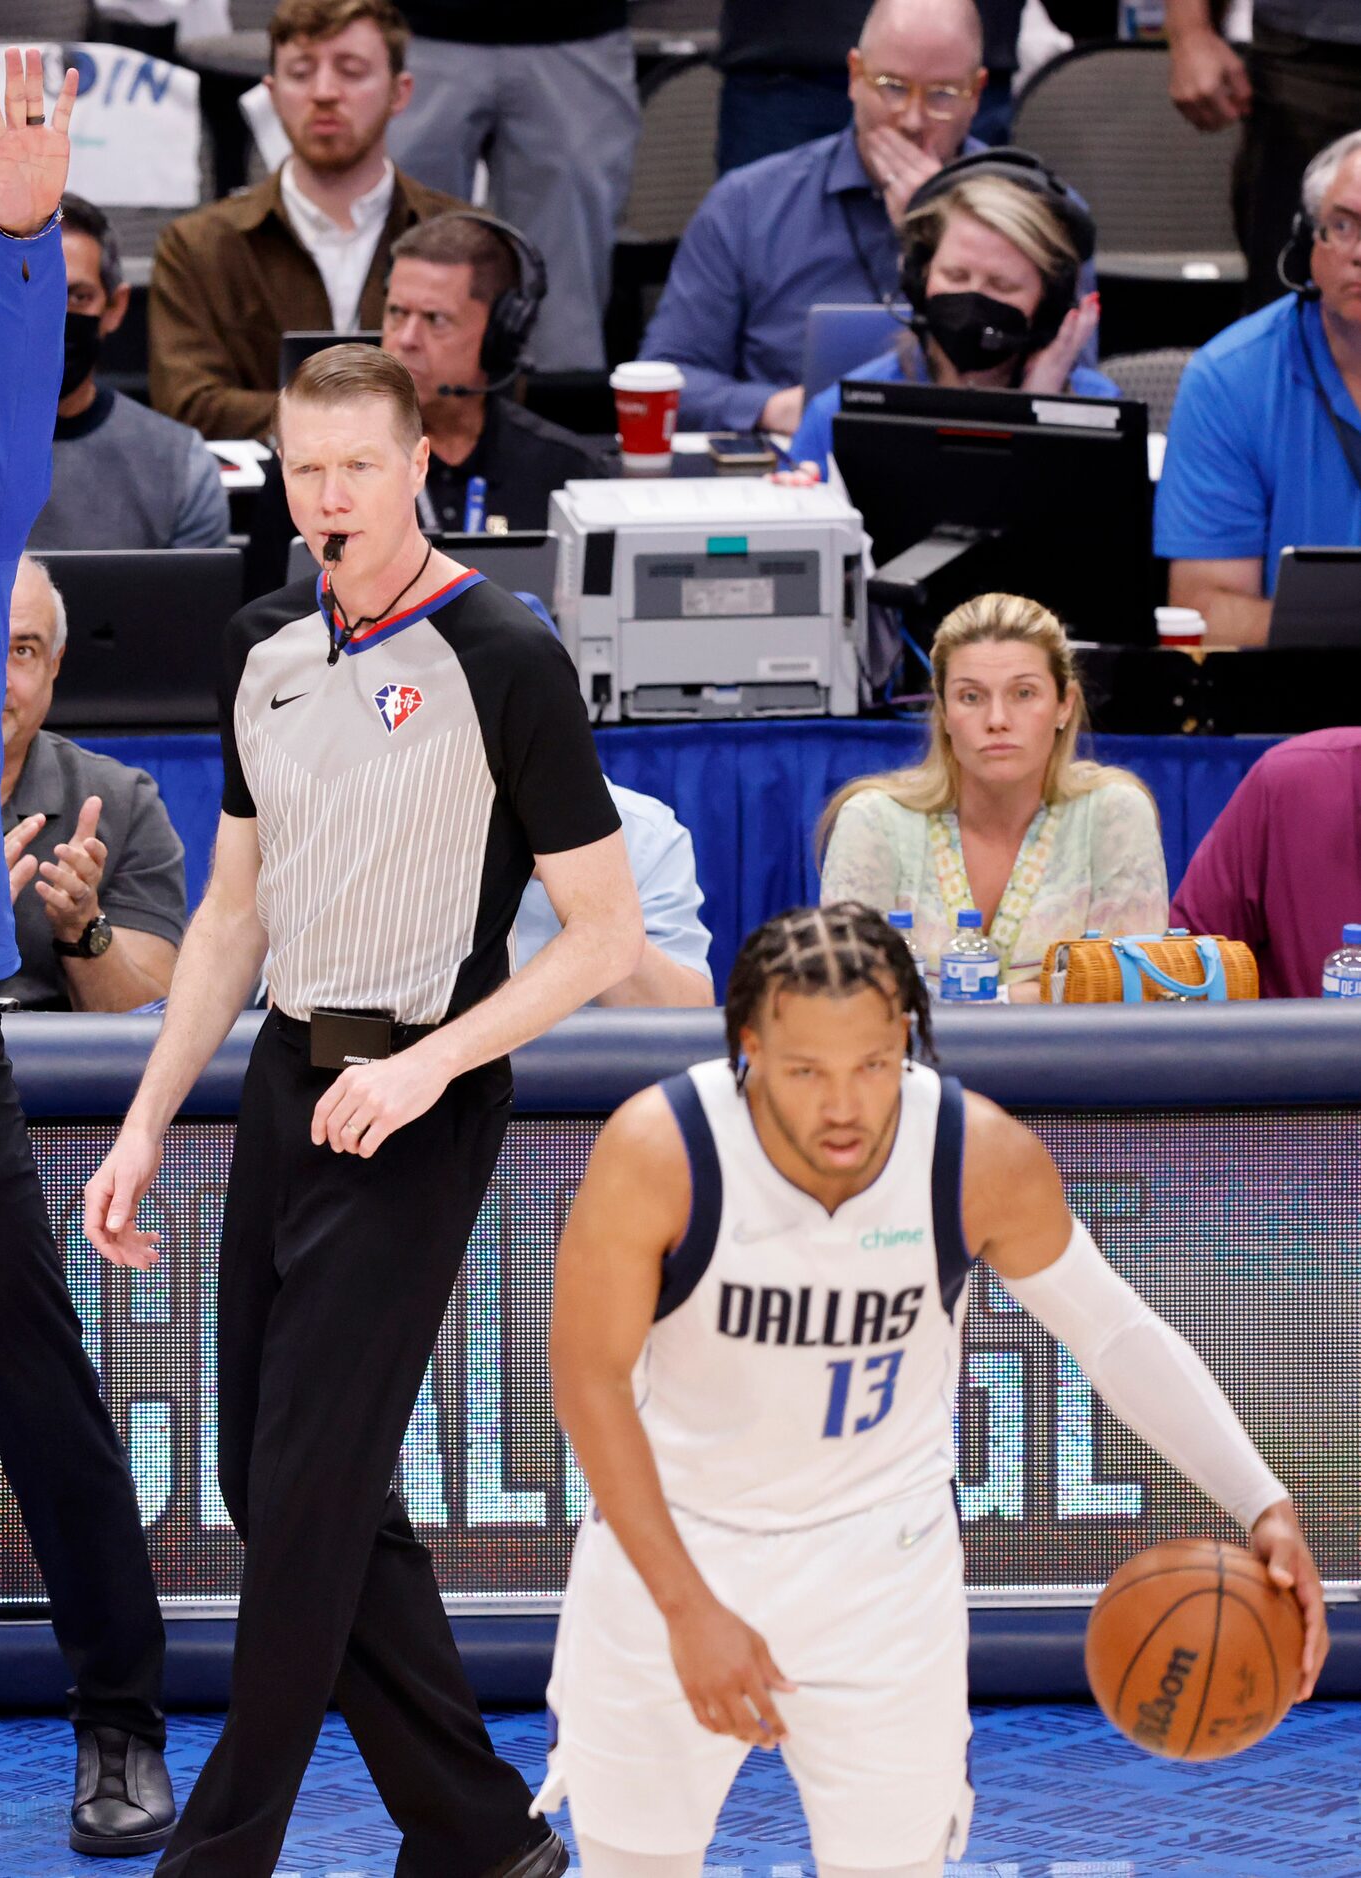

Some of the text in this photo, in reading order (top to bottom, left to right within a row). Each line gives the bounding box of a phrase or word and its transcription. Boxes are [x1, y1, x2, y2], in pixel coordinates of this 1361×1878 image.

[402, 693, 415, 710] 75
[860, 1227, 925, 1250] chime
[716, 1281, 926, 1347] DALLAS
[821, 1350, 906, 1440] 13
[1015, 1733, 1152, 1773] HUBE
[980, 1773, 1138, 1803] CHARLIE
[1174, 1776, 1360, 1818] ERICK
[970, 1821, 1157, 1860] ARDAWAY
[1017, 1805, 1188, 1839] DOUG
[1158, 1828, 1355, 1867] SMITH
